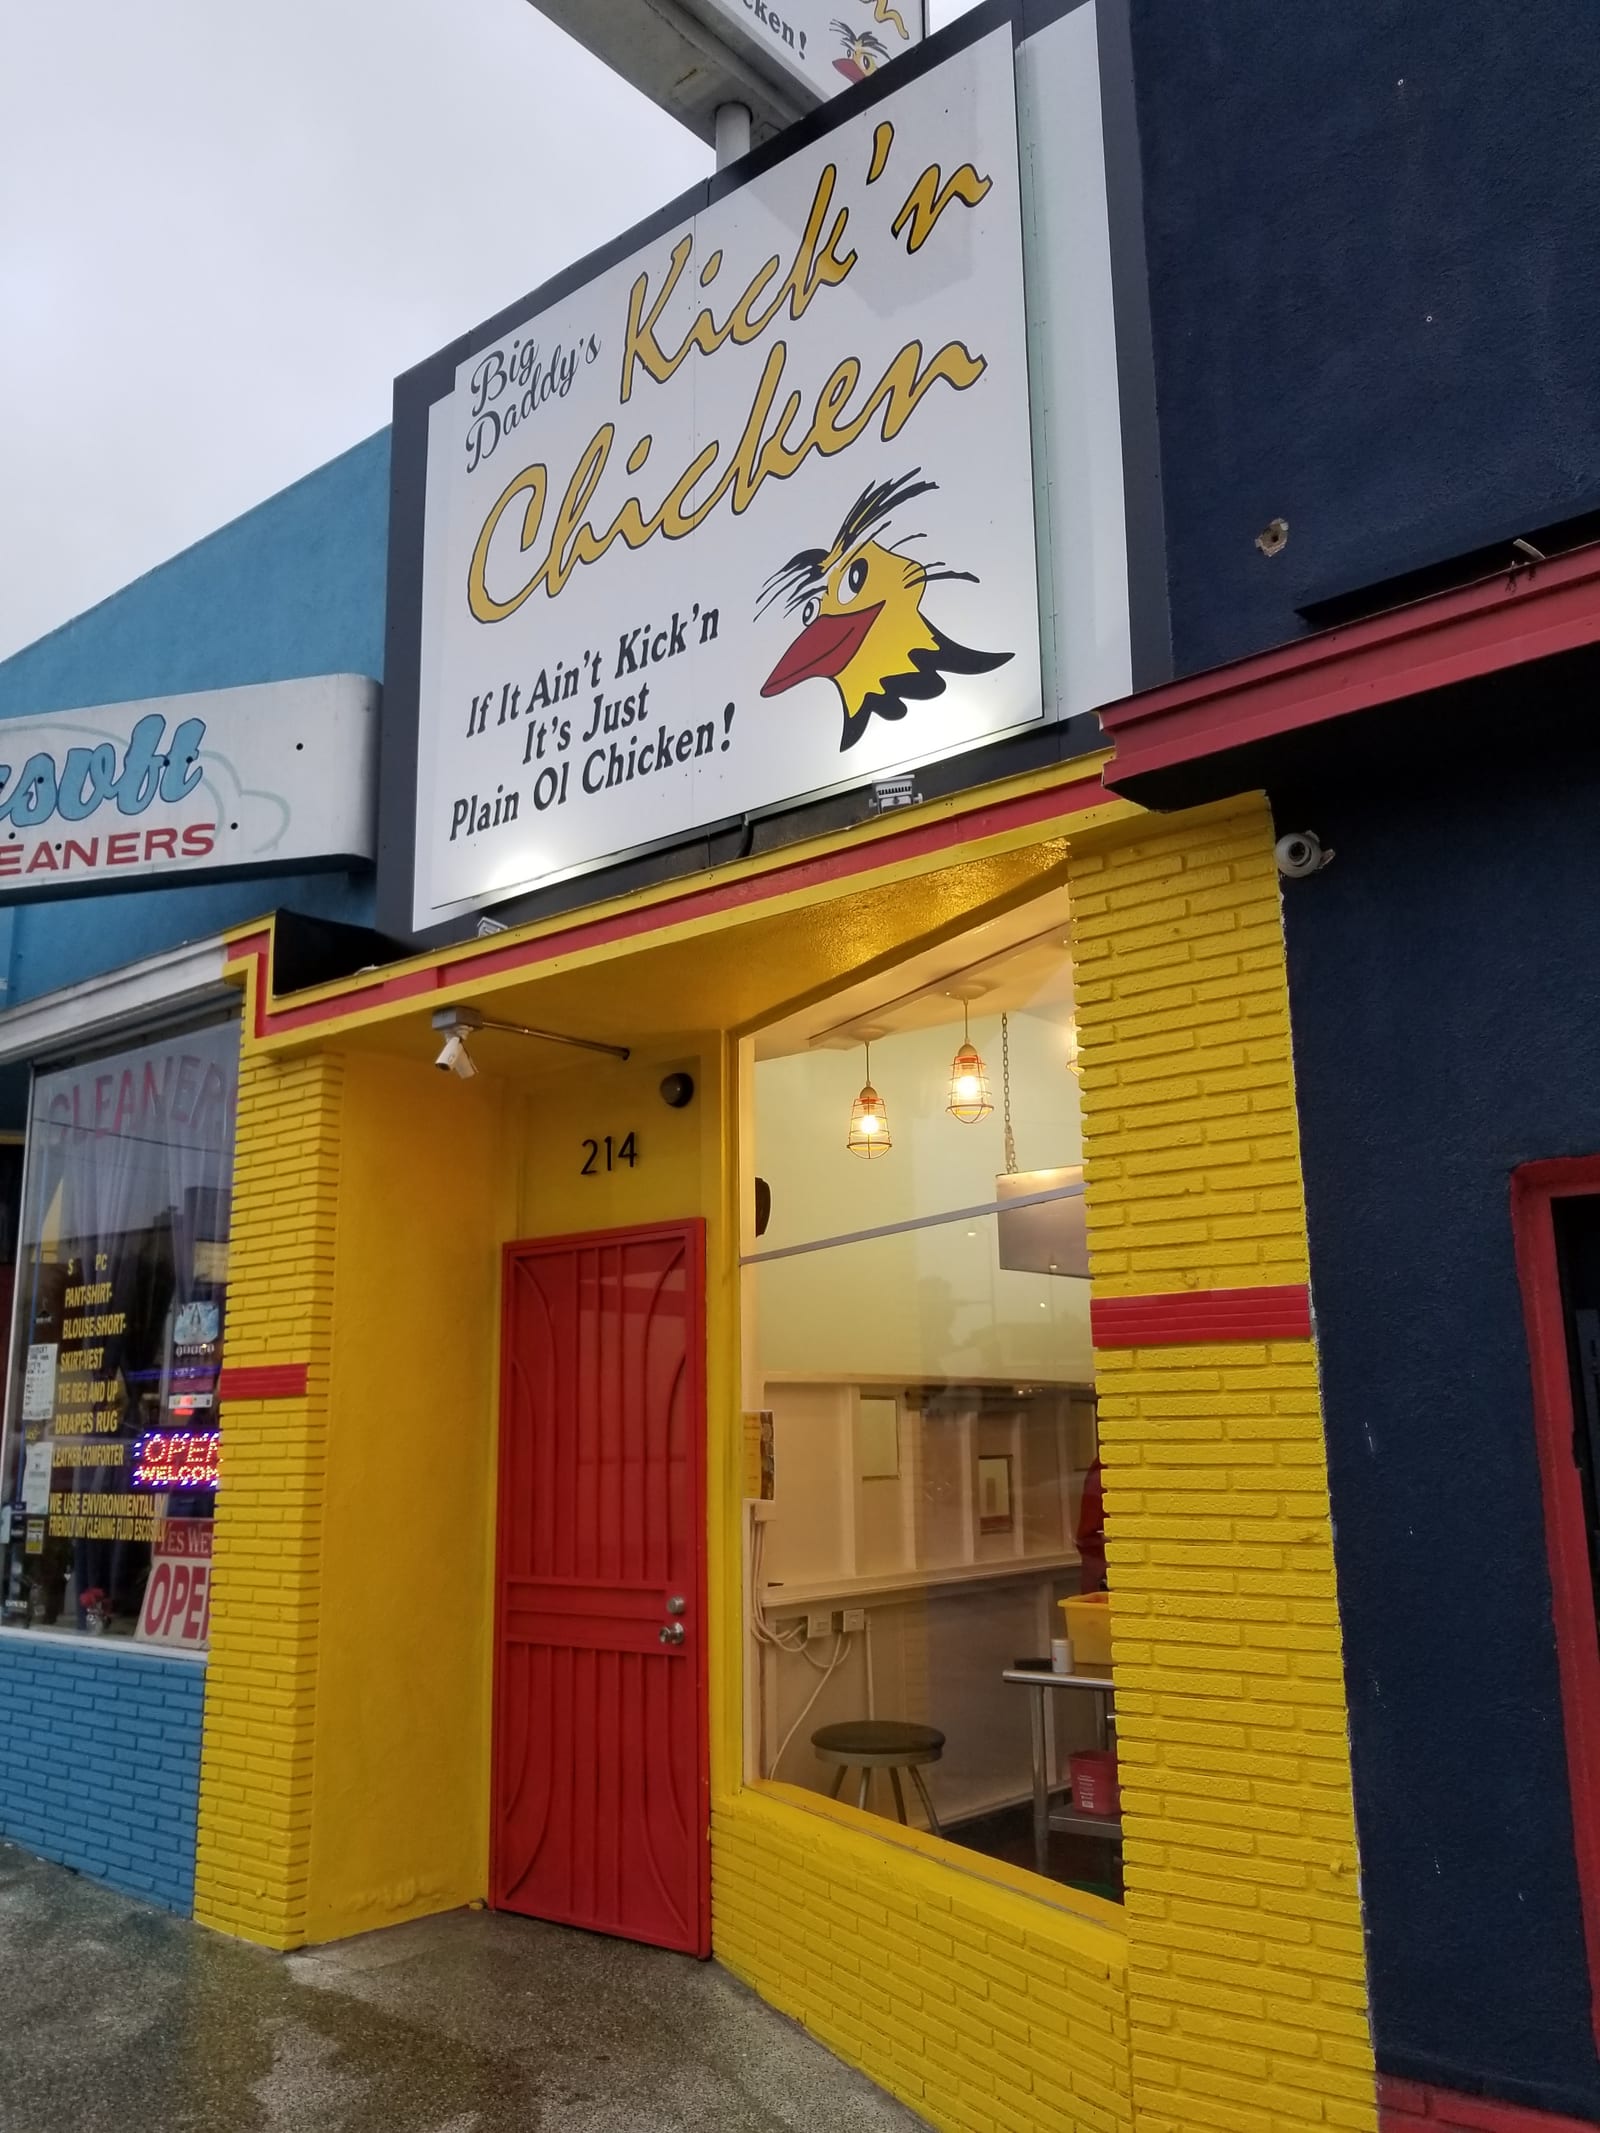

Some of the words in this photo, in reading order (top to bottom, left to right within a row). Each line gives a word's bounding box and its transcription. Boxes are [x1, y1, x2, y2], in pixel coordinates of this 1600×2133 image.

[620, 121, 993, 404] Kick'n
[465, 333, 602, 474] Daddy's
[470, 338, 540, 418] Big
[466, 339, 988, 624] Chicken
[466, 691, 494, 738] If
[497, 682, 521, 726] It
[525, 649, 602, 715] Ain't
[614, 602, 720, 680] Kick'n
[522, 715, 572, 765] It's
[582, 681, 650, 743] Just
[449, 783, 520, 842] Plain
[533, 761, 570, 812] Ol
[581, 701, 736, 795] Chicken!
[0, 823, 216, 877] EANERS
[50, 1055, 238, 1146] CLEANER
[581, 1131, 638, 1176] 214
[55, 1411, 94, 1435] DRAPES
[95, 1410, 118, 1433] RUG
[58, 1382, 70, 1404] TIE
[88, 1380, 105, 1402] AND
[106, 1379, 119, 1402] UP
[49, 1492, 63, 1514] WE
[63, 1492, 81, 1515] USE
